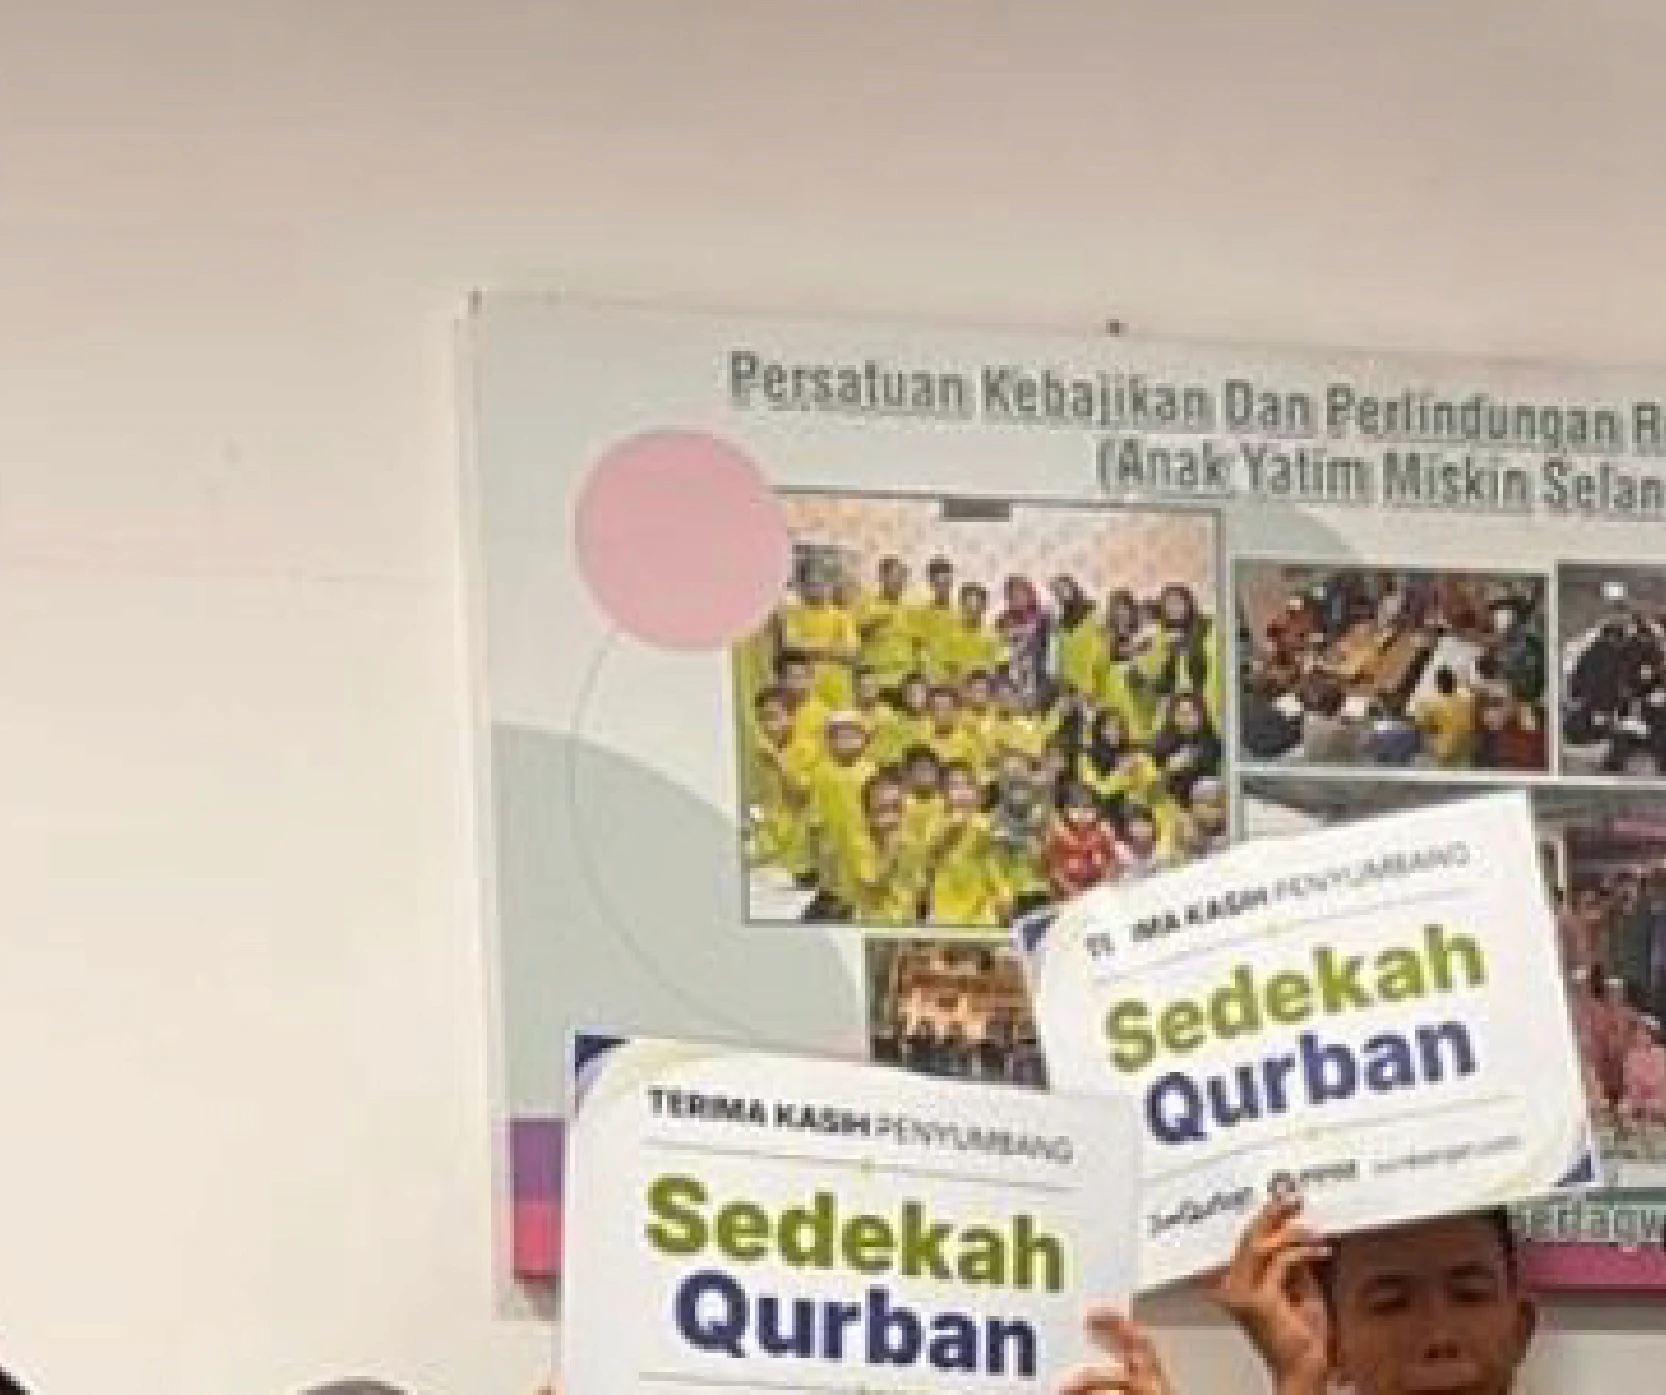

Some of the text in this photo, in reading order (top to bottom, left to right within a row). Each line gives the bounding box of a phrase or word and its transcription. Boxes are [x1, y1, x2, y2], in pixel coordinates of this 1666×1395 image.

[730, 351, 965, 415] Persatuan
[981, 364, 1216, 430] Kebajikan
[1224, 377, 1313, 433] Dan
[1326, 385, 1618, 455] Perlindungan
[1098, 436, 1232, 495] (Anak
[1243, 444, 1371, 502] Yatim
[1382, 452, 1531, 508] Miskin
[1105, 923, 1487, 1074] Sedekah
[646, 1087, 1076, 1165] TERIMA KASIH PENYUMBANG
[1145, 1018, 1479, 1146] Qurban
[646, 1173, 1066, 1293] Sedekah
[673, 1269, 1038, 1377] Qurban
